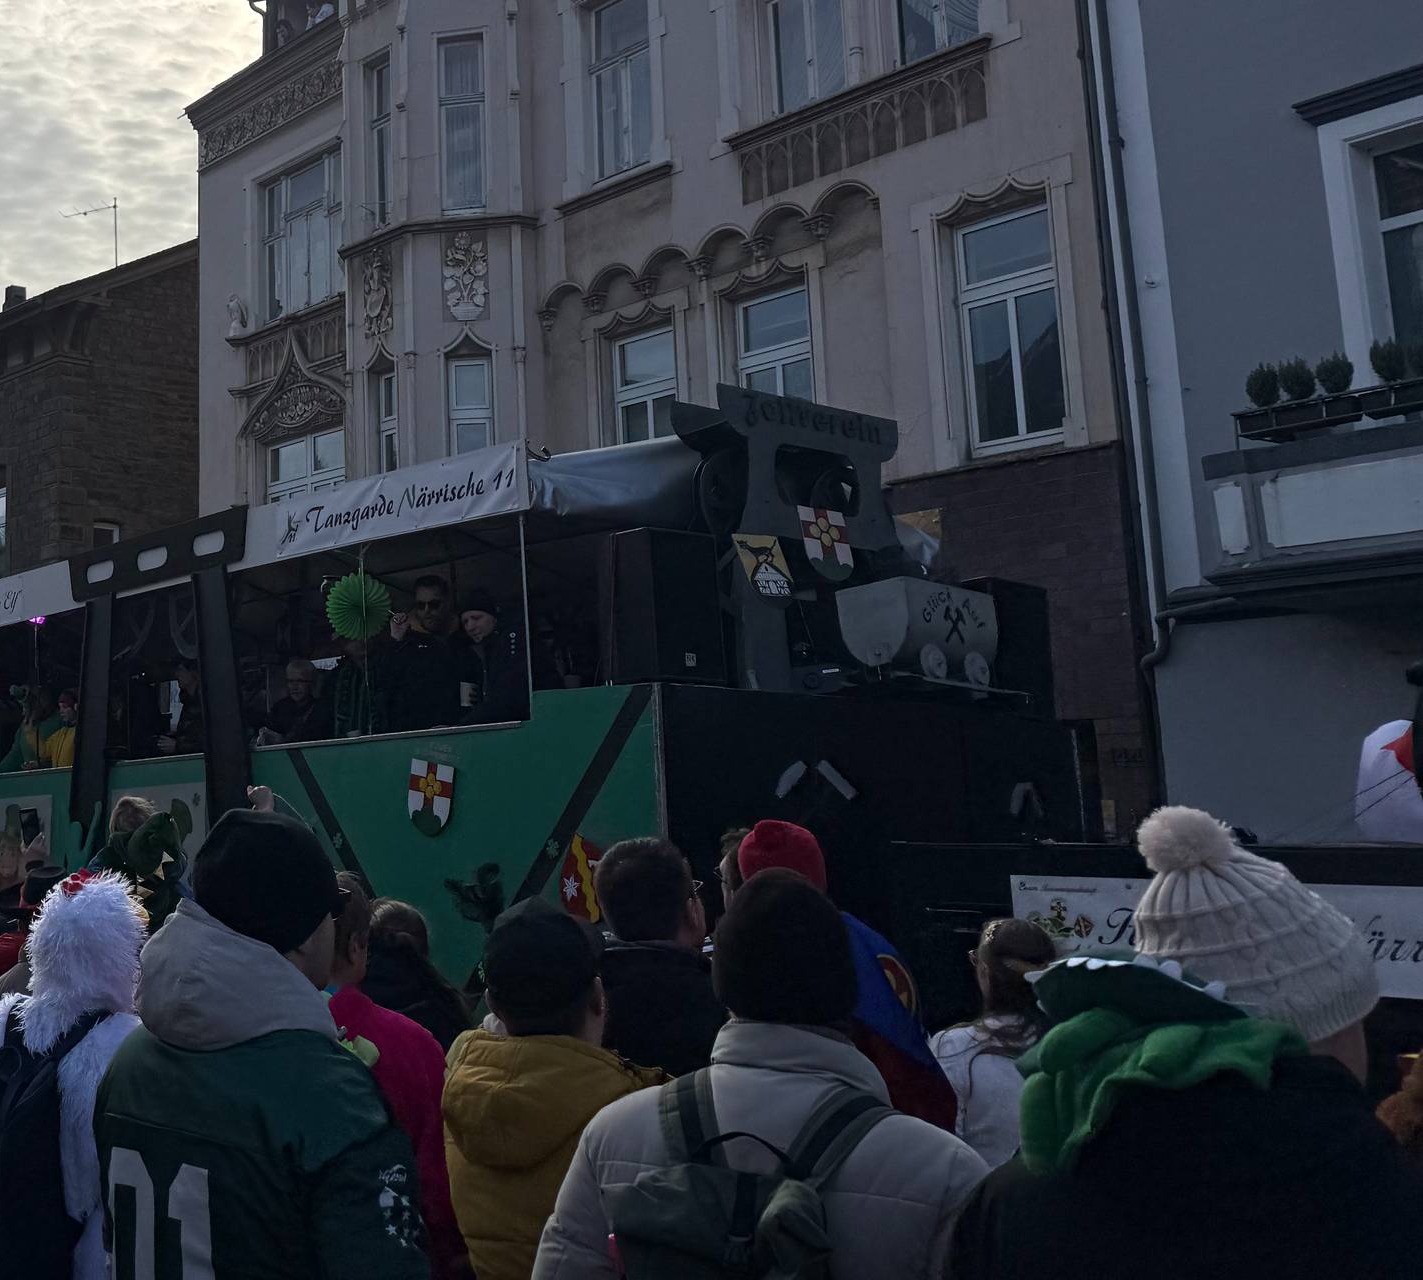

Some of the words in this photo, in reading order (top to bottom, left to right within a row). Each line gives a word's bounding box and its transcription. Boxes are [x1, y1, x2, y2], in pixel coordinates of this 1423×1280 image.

[306, 494, 394, 533] Tanzgarde
[397, 472, 485, 518] Närrische
[494, 468, 515, 490] 11
